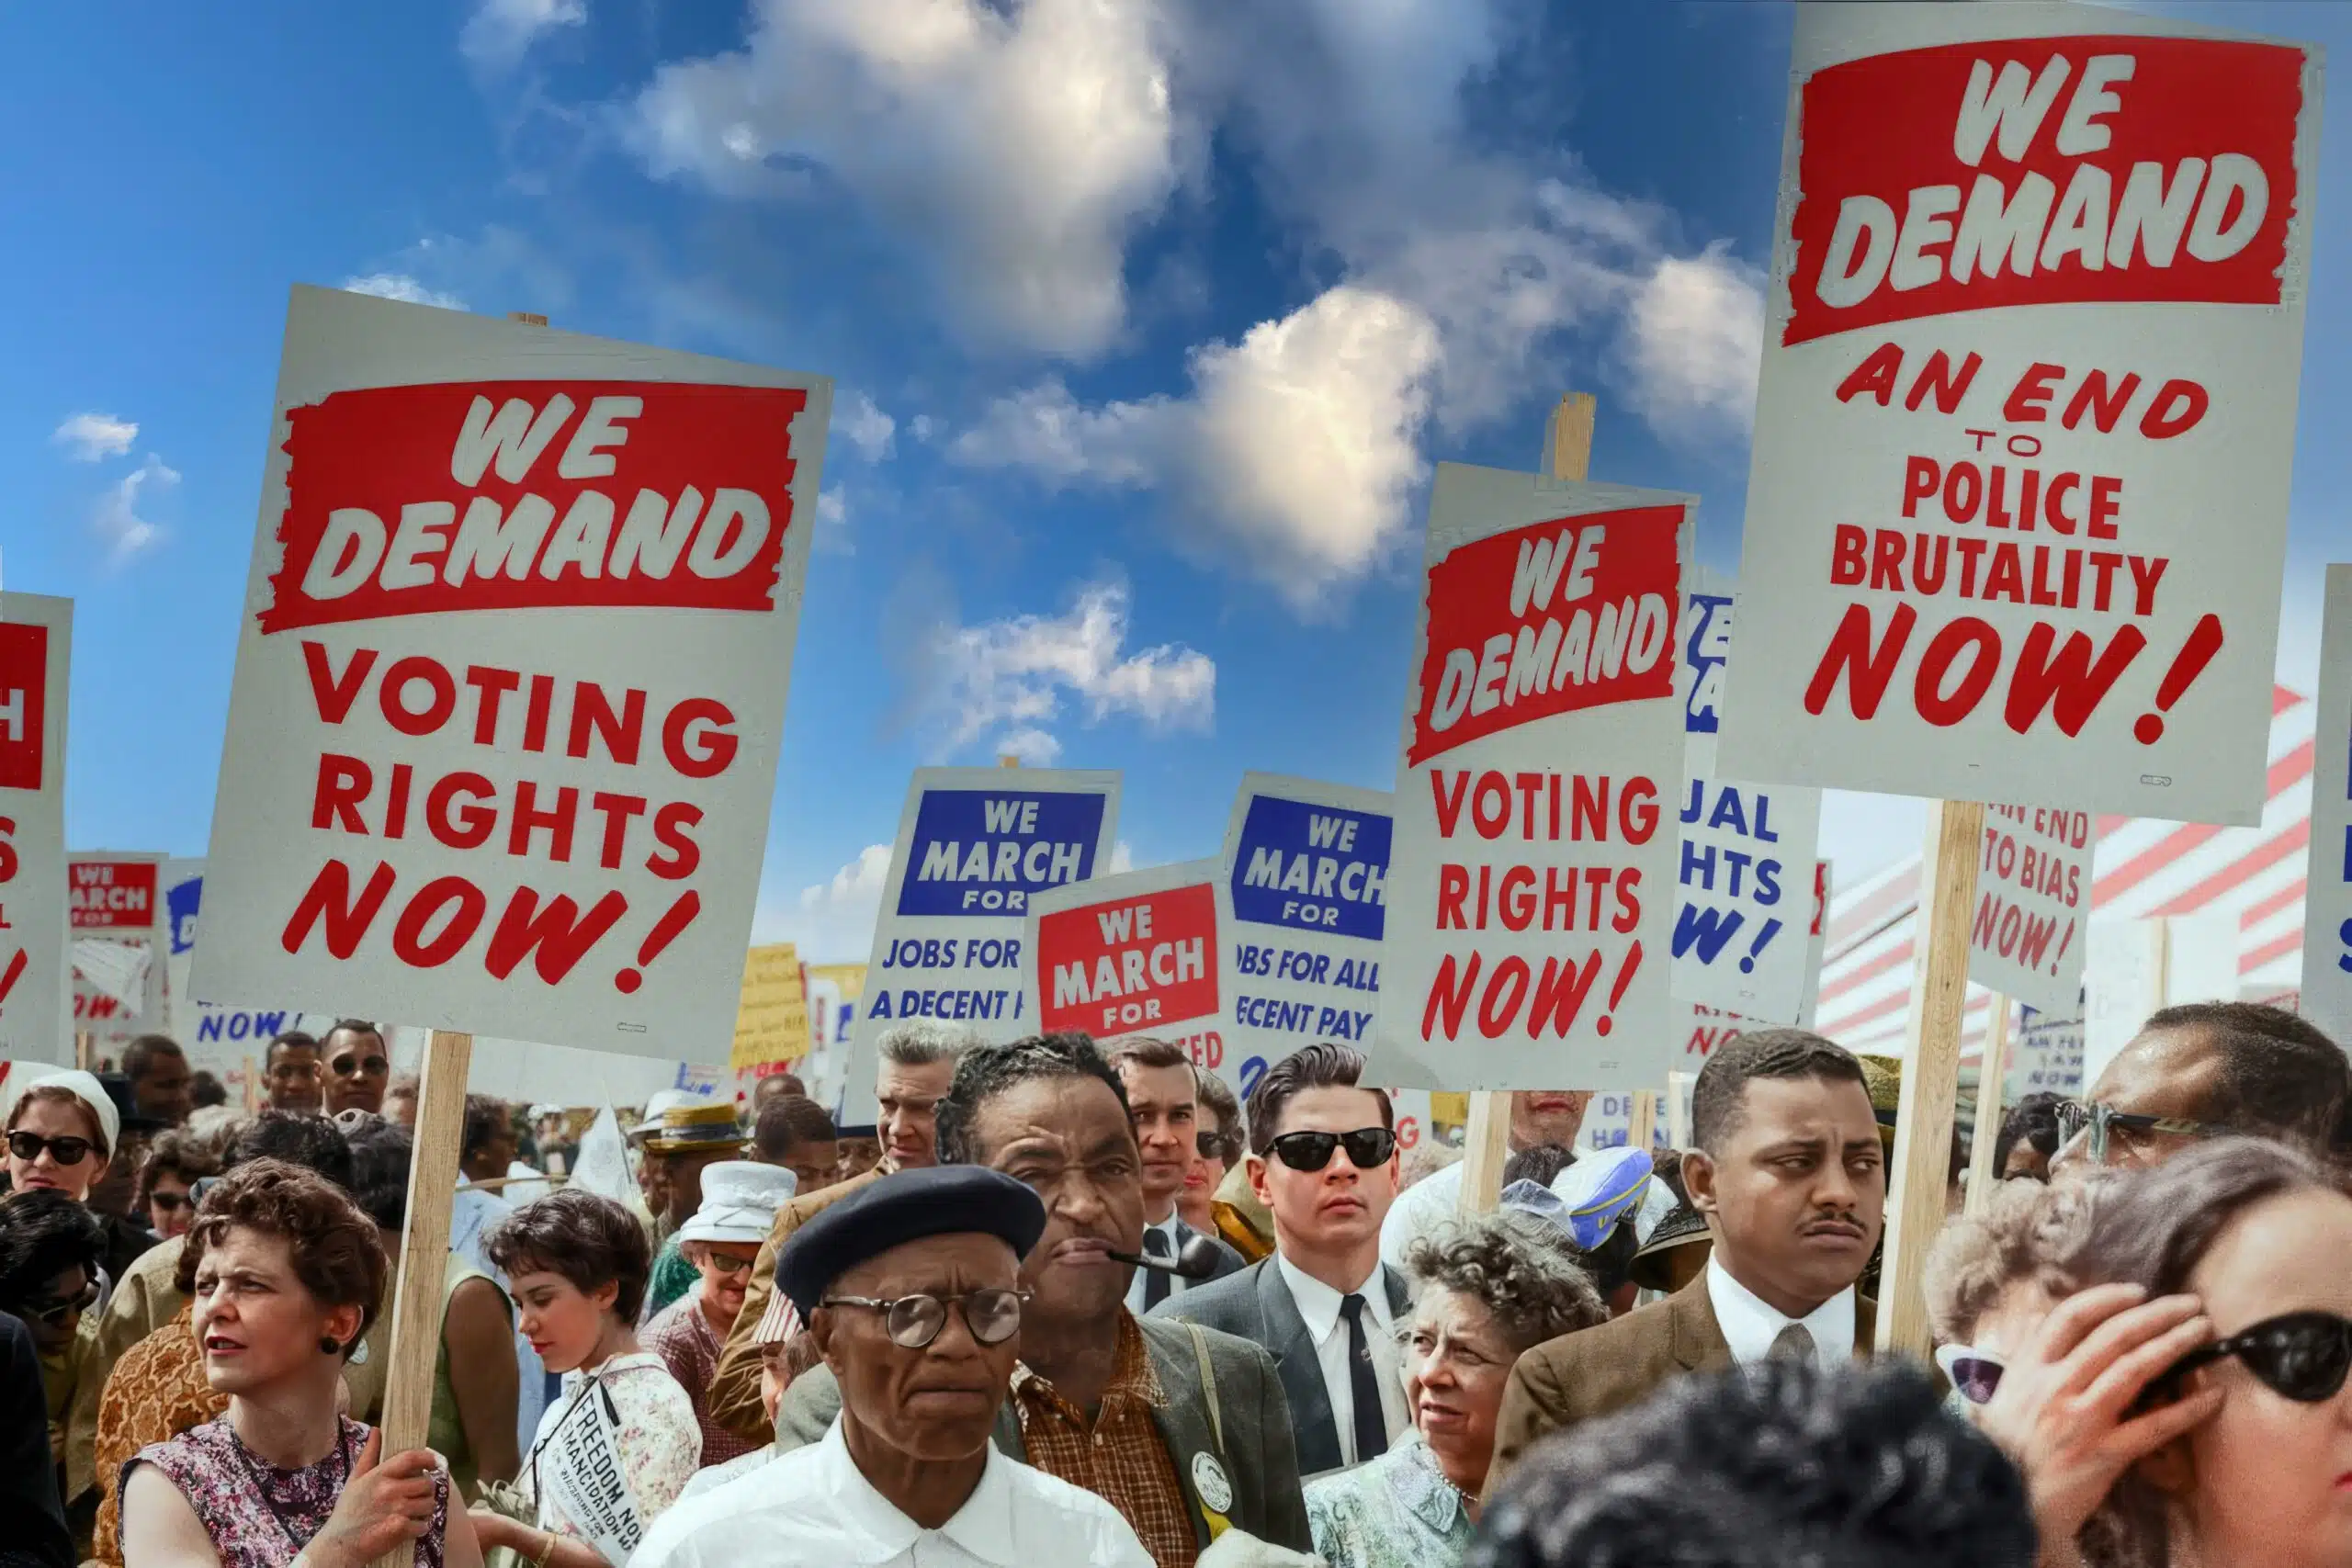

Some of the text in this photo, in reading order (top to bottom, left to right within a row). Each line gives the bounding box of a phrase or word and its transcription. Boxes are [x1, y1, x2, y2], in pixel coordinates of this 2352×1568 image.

[1953, 53, 2136, 167] WE
[1815, 152, 2269, 309] DEMAND
[1837, 342, 2210, 439] AN END
[451, 393, 643, 487] WE
[1964, 428, 2041, 457] TO
[1902, 456, 2123, 540] POLICE
[300, 486, 771, 601] DEMAND
[1510, 525, 1606, 617] WE
[1830, 524, 2169, 615] BRUTALITY
[1430, 593, 1668, 732] DEMAND
[1804, 602, 2223, 746] NOW!
[300, 641, 739, 778] VOTING
[311, 752, 704, 879] RIGHTS
[984, 800, 1038, 833] WE
[1308, 814, 1359, 852] WE
[1430, 769, 1660, 846] VOTING
[76, 865, 114, 885] WE
[918, 841, 1082, 883] MARCH
[962, 889, 1025, 910] FOR
[1243, 847, 1386, 906] MARCH
[1436, 864, 1642, 934] RIGHTS
[1985, 827, 2080, 908] TO BIAS
[281, 858, 701, 994] NOW!
[882, 939, 1020, 968] JOBS FOR
[1098, 905, 1151, 944] WE
[1283, 900, 1339, 927] FOR
[1972, 891, 2075, 977] NOW!
[868, 992, 892, 1020] A
[899, 990, 1009, 1020] DECENT
[1053, 937, 1204, 1009] MARCH
[1278, 950, 1329, 984] FOR
[1332, 958, 1378, 992] ALL
[1421, 939, 1643, 1042] NOW!
[1102, 998, 1162, 1030] FOR
[1317, 1005, 1373, 1042] PAY
[560, 1417, 621, 1536] EMANCIPATION
[574, 1391, 625, 1506] FREEDOM
